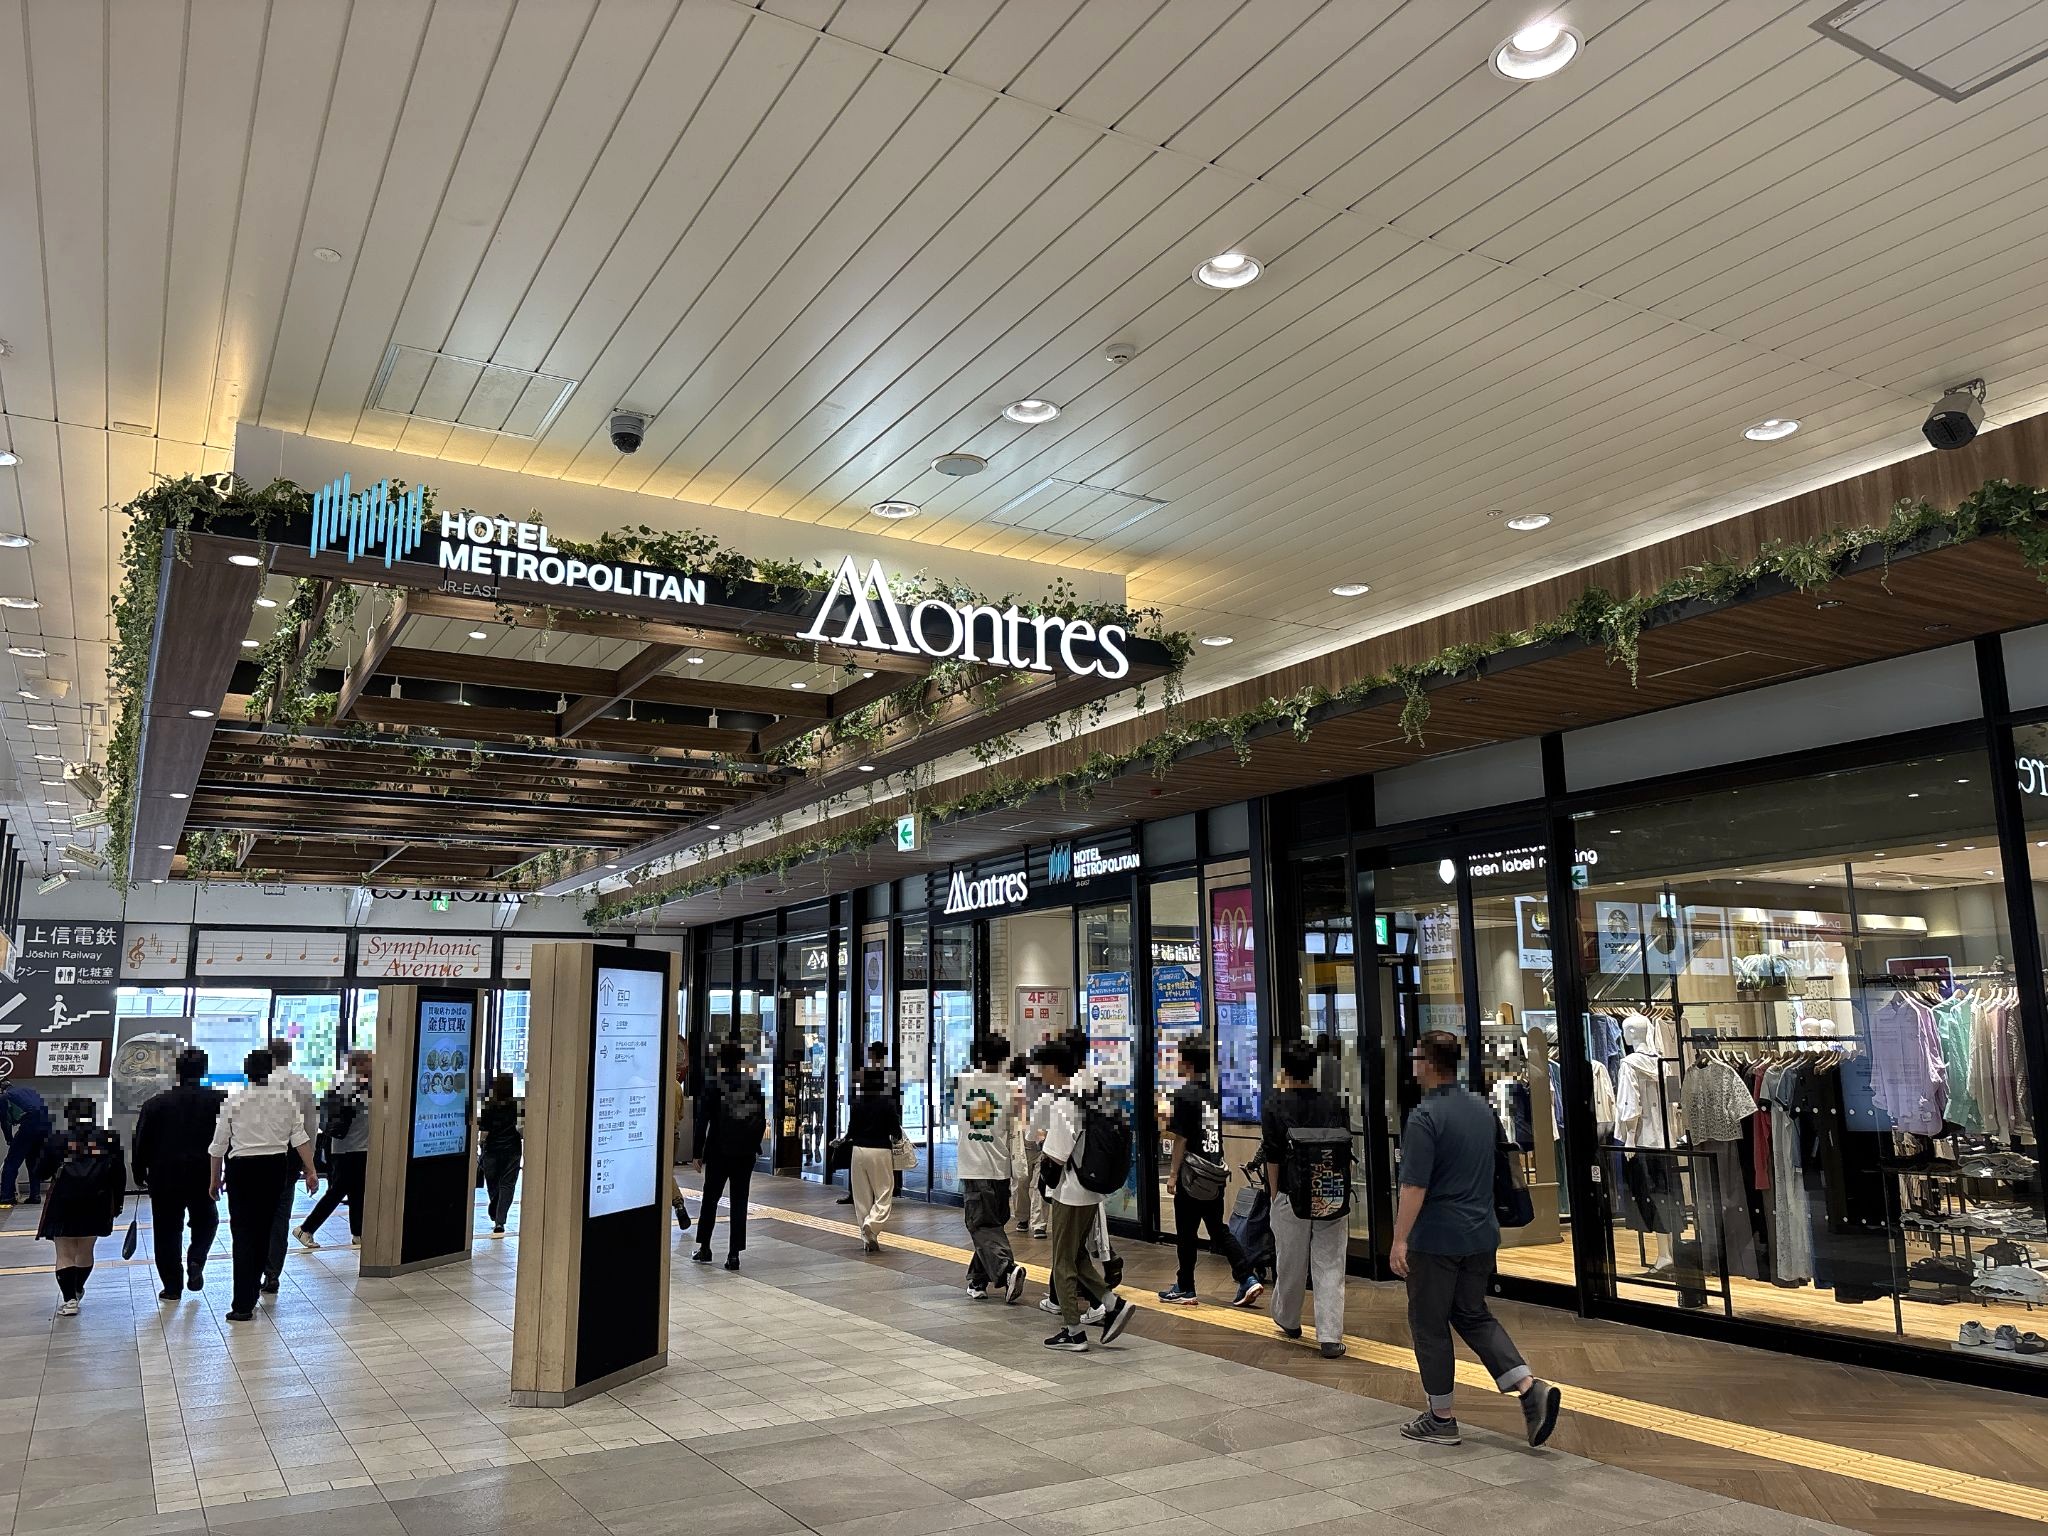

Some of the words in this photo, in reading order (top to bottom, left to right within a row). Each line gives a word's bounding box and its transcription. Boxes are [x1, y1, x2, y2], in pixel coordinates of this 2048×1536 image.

[440, 510, 559, 554] HOTEL
[439, 541, 706, 606] METROPOLITAN
[438, 580, 501, 598] JR-EAST
[796, 554, 1130, 680] Montres
[1073, 847, 1101, 865] HOTEL
[1073, 853, 1141, 879] METROPOLITAN
[1502, 859, 1534, 873] label
[943, 870, 1029, 915] Montres
[27, 926, 117, 946] 上信電鉄
[26, 949, 59, 960] Jōshin
[62, 950, 103, 962] Railway
[368, 936, 482, 960] Symphonic
[16, 966, 50, 977] クシー
[78, 967, 114, 978] 化粧室
[383, 957, 464, 977] Avenue
[617, 989, 630, 1001] 西口
[1028, 992, 1045, 1003] 4F
[0, 1041, 28, 1051] 電鉄
[50, 1042, 90, 1051] 世界遺産
[1310, 1162, 1323, 1197] FACE
[1321, 1149, 1334, 1197] NORTH
[1333, 1170, 1345, 1198] THE
